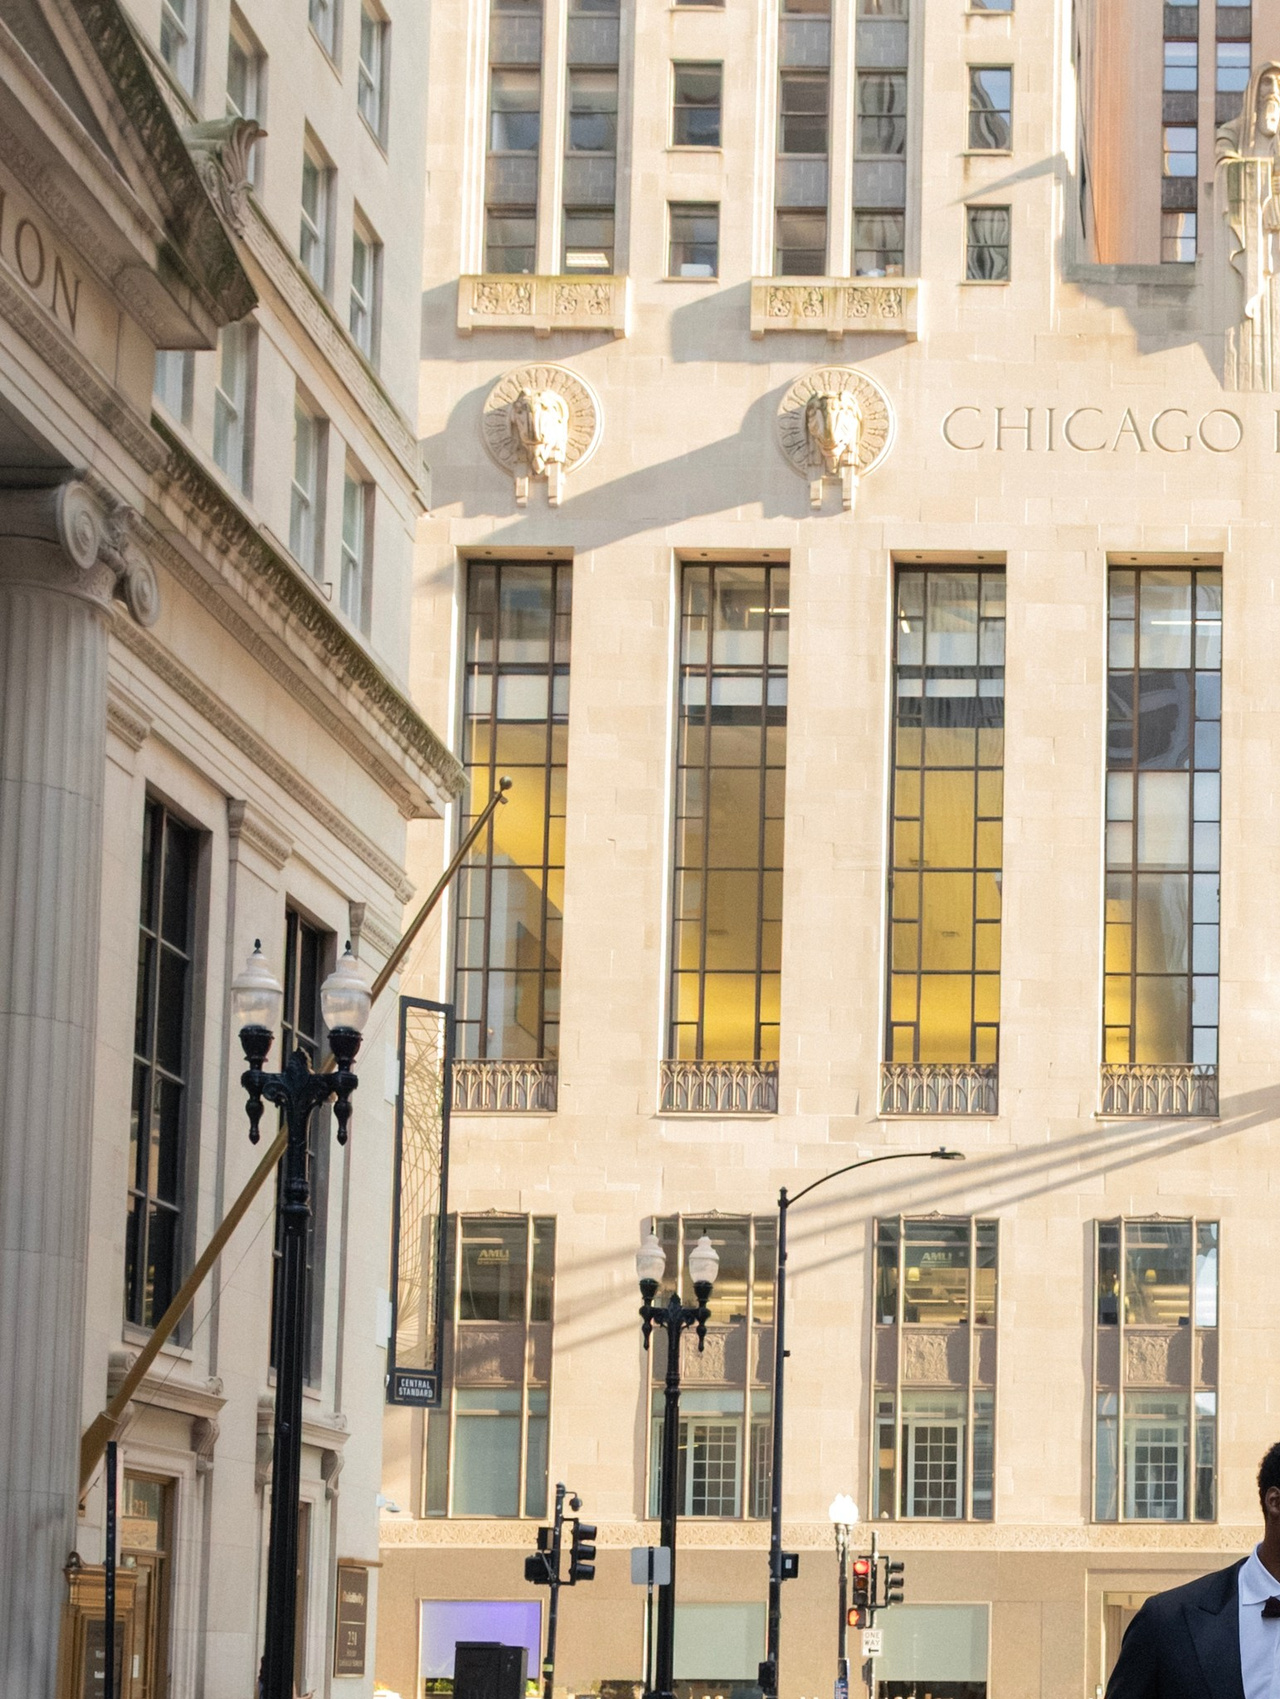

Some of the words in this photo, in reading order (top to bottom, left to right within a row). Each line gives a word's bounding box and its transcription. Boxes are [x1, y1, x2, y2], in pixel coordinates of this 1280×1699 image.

[940, 406, 1244, 453] CHICAGO
[480, 1249, 509, 1258] AMLI
[922, 1252, 952, 1261] AMLI
[401, 1379, 430, 1389] CENTRAL
[398, 1387, 433, 1398] STANDARD
